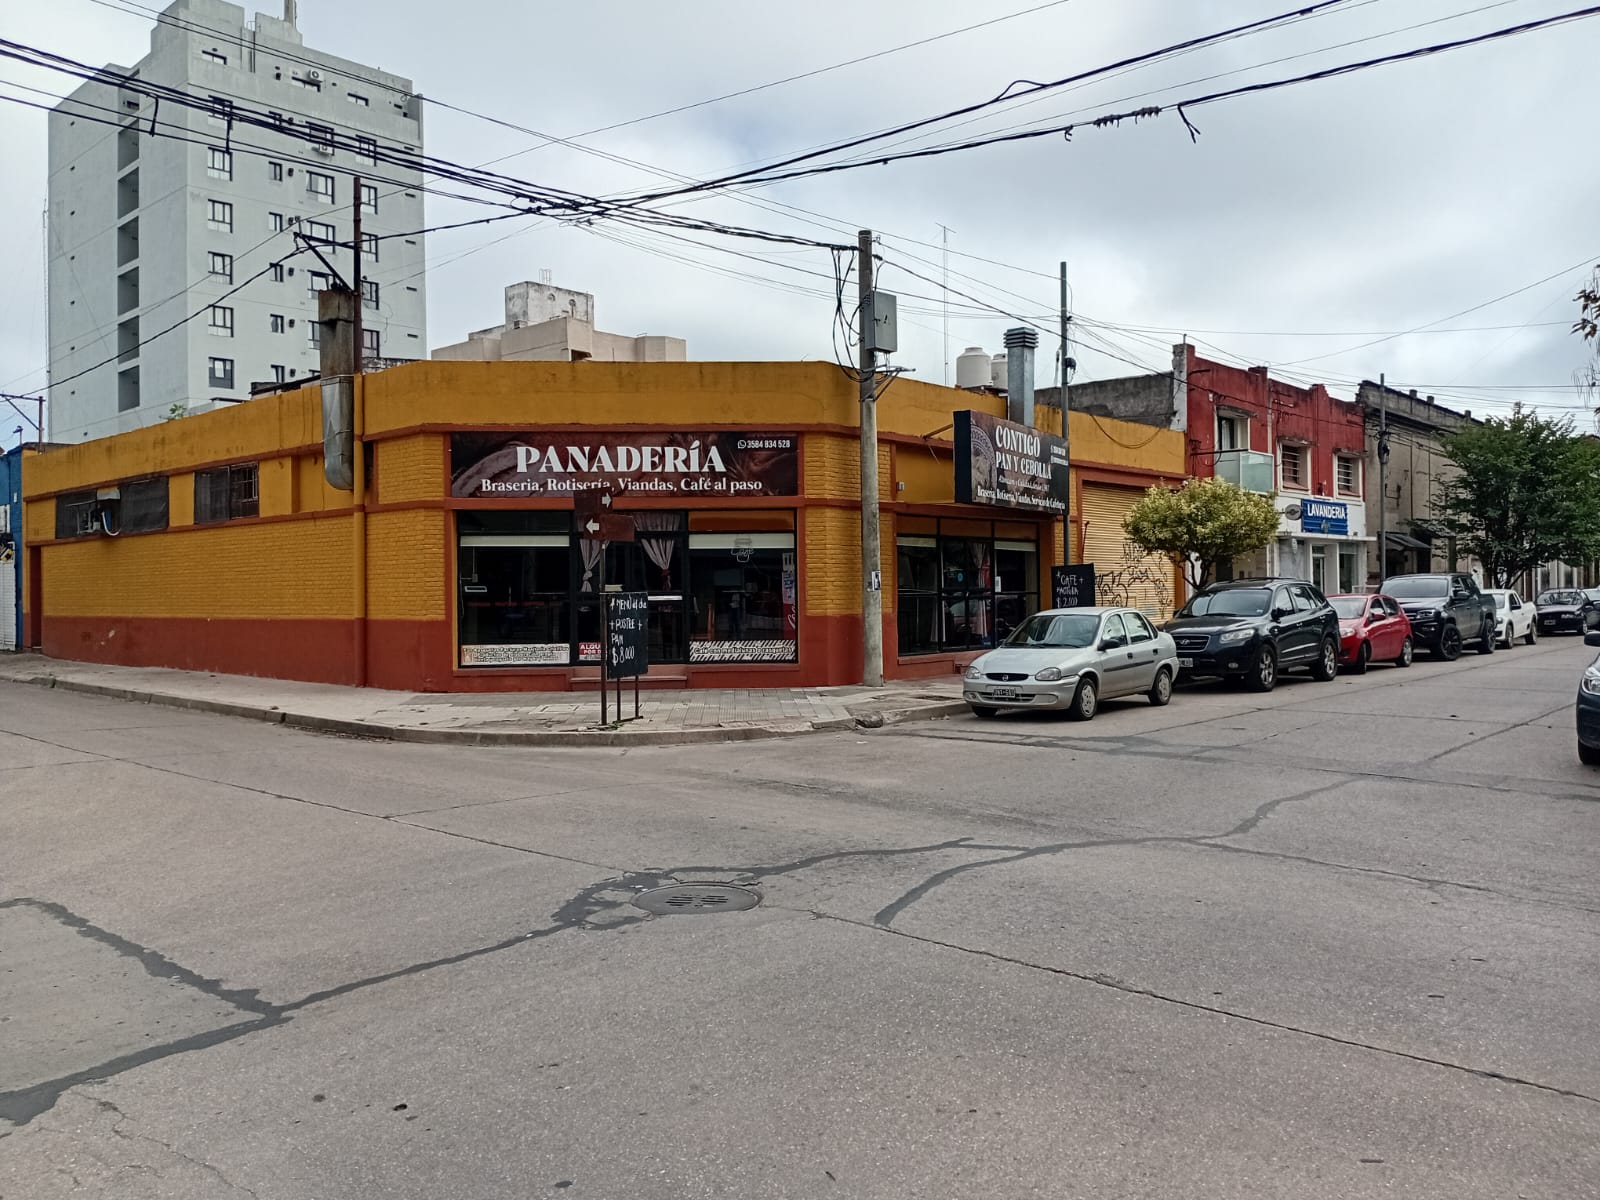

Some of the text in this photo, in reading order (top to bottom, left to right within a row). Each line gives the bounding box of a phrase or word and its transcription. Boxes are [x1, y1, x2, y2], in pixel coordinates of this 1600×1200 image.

[995, 425, 1041, 458] CONTIGO
[516, 439, 727, 473] PANADERÍA
[995, 451, 1012, 470] PAN
[1013, 455, 1019, 472] Y
[1020, 458, 1052, 480] CEBOLLA
[481, 478, 543, 493] Braseria,
[617, 478, 677, 492] Viandas,
[680, 478, 712, 491] Café
[714, 478, 727, 491] al
[730, 482, 763, 494] paso
[1307, 503, 1346, 519] LAVANDERIA
[611, 632, 624, 647] PAN
